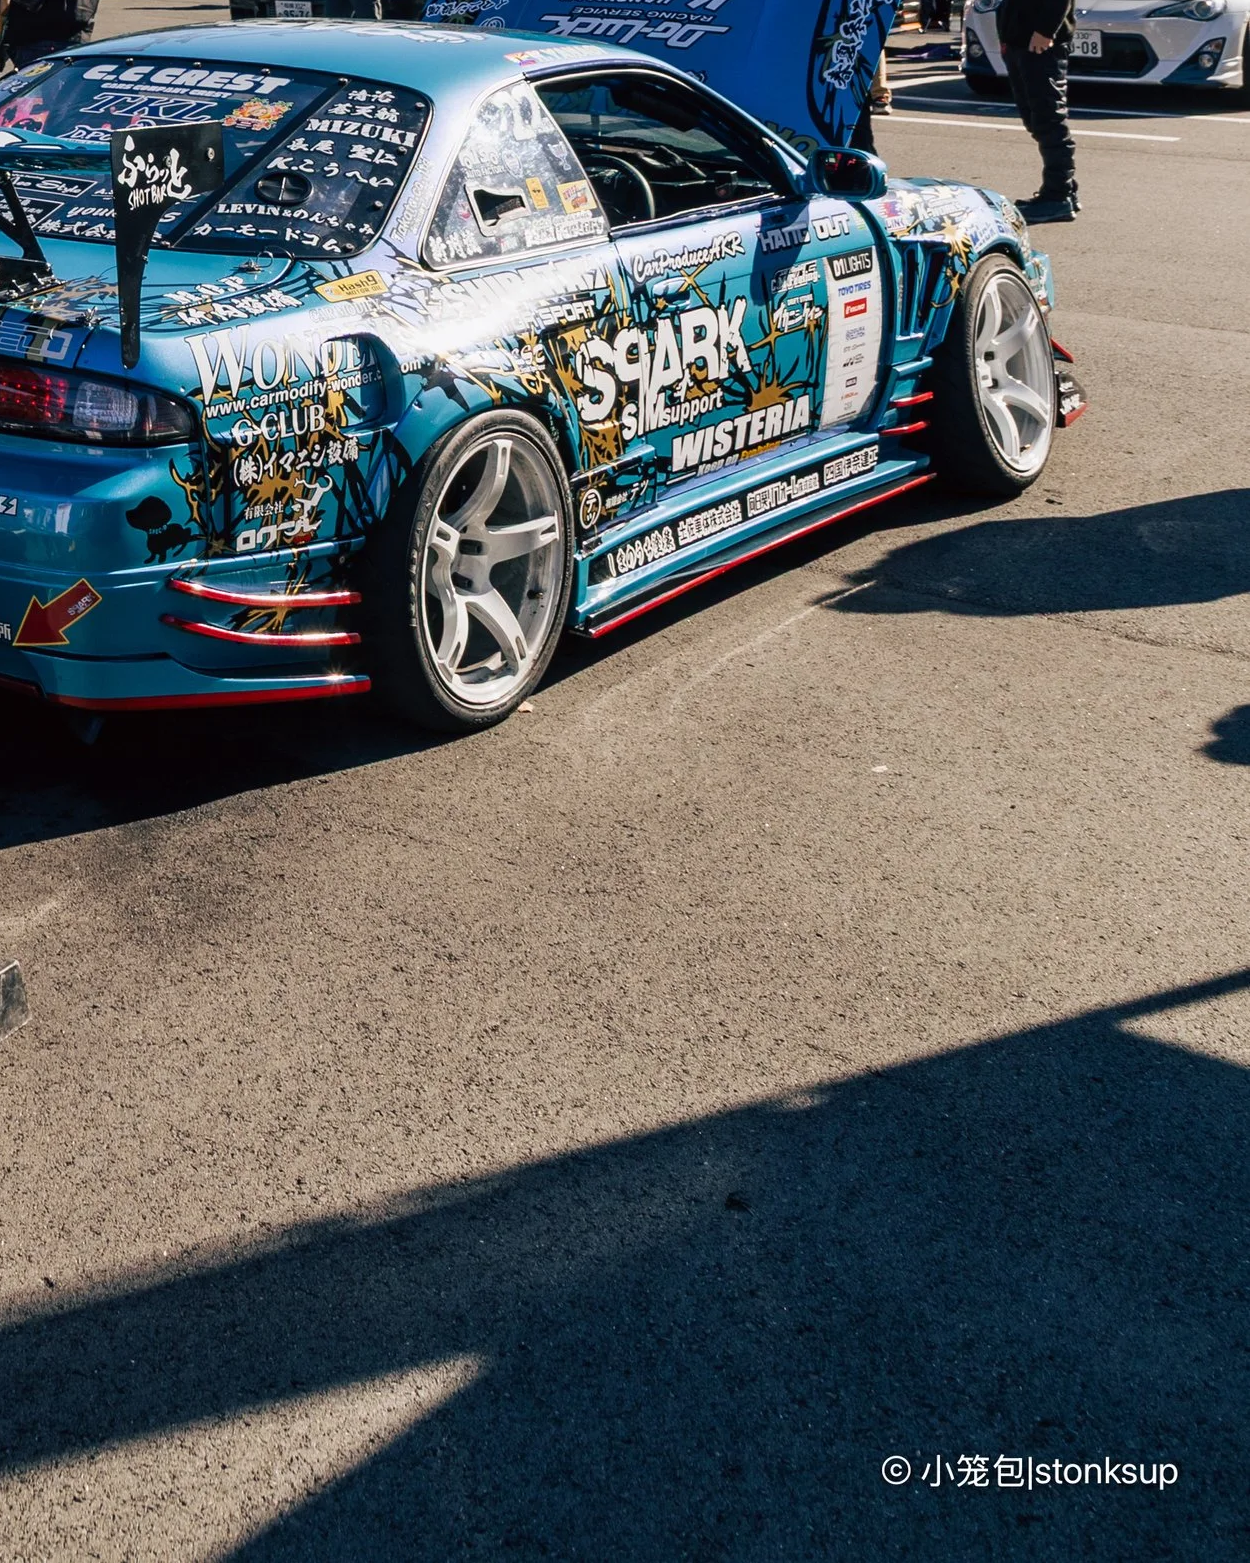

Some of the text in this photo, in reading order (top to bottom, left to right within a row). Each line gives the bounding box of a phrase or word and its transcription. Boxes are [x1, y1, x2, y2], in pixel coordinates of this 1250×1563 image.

[571, 6, 714, 23] RACING SERVICE
[149, 68, 293, 95] CREST
[188, 88, 235, 99] CREST
[79, 92, 219, 123] TKL
[305, 118, 418, 148] MIZUKI
[128, 186, 150, 211] SHOT
[151, 184, 167, 205] BAR
[811, 212, 850, 241] OUT
[337, 274, 377, 293] Hash9
[838, 281, 871, 297] TOYO TIRES
[671, 394, 810, 472] WISTERIA
[243, 501, 284, 520] 有限会社
